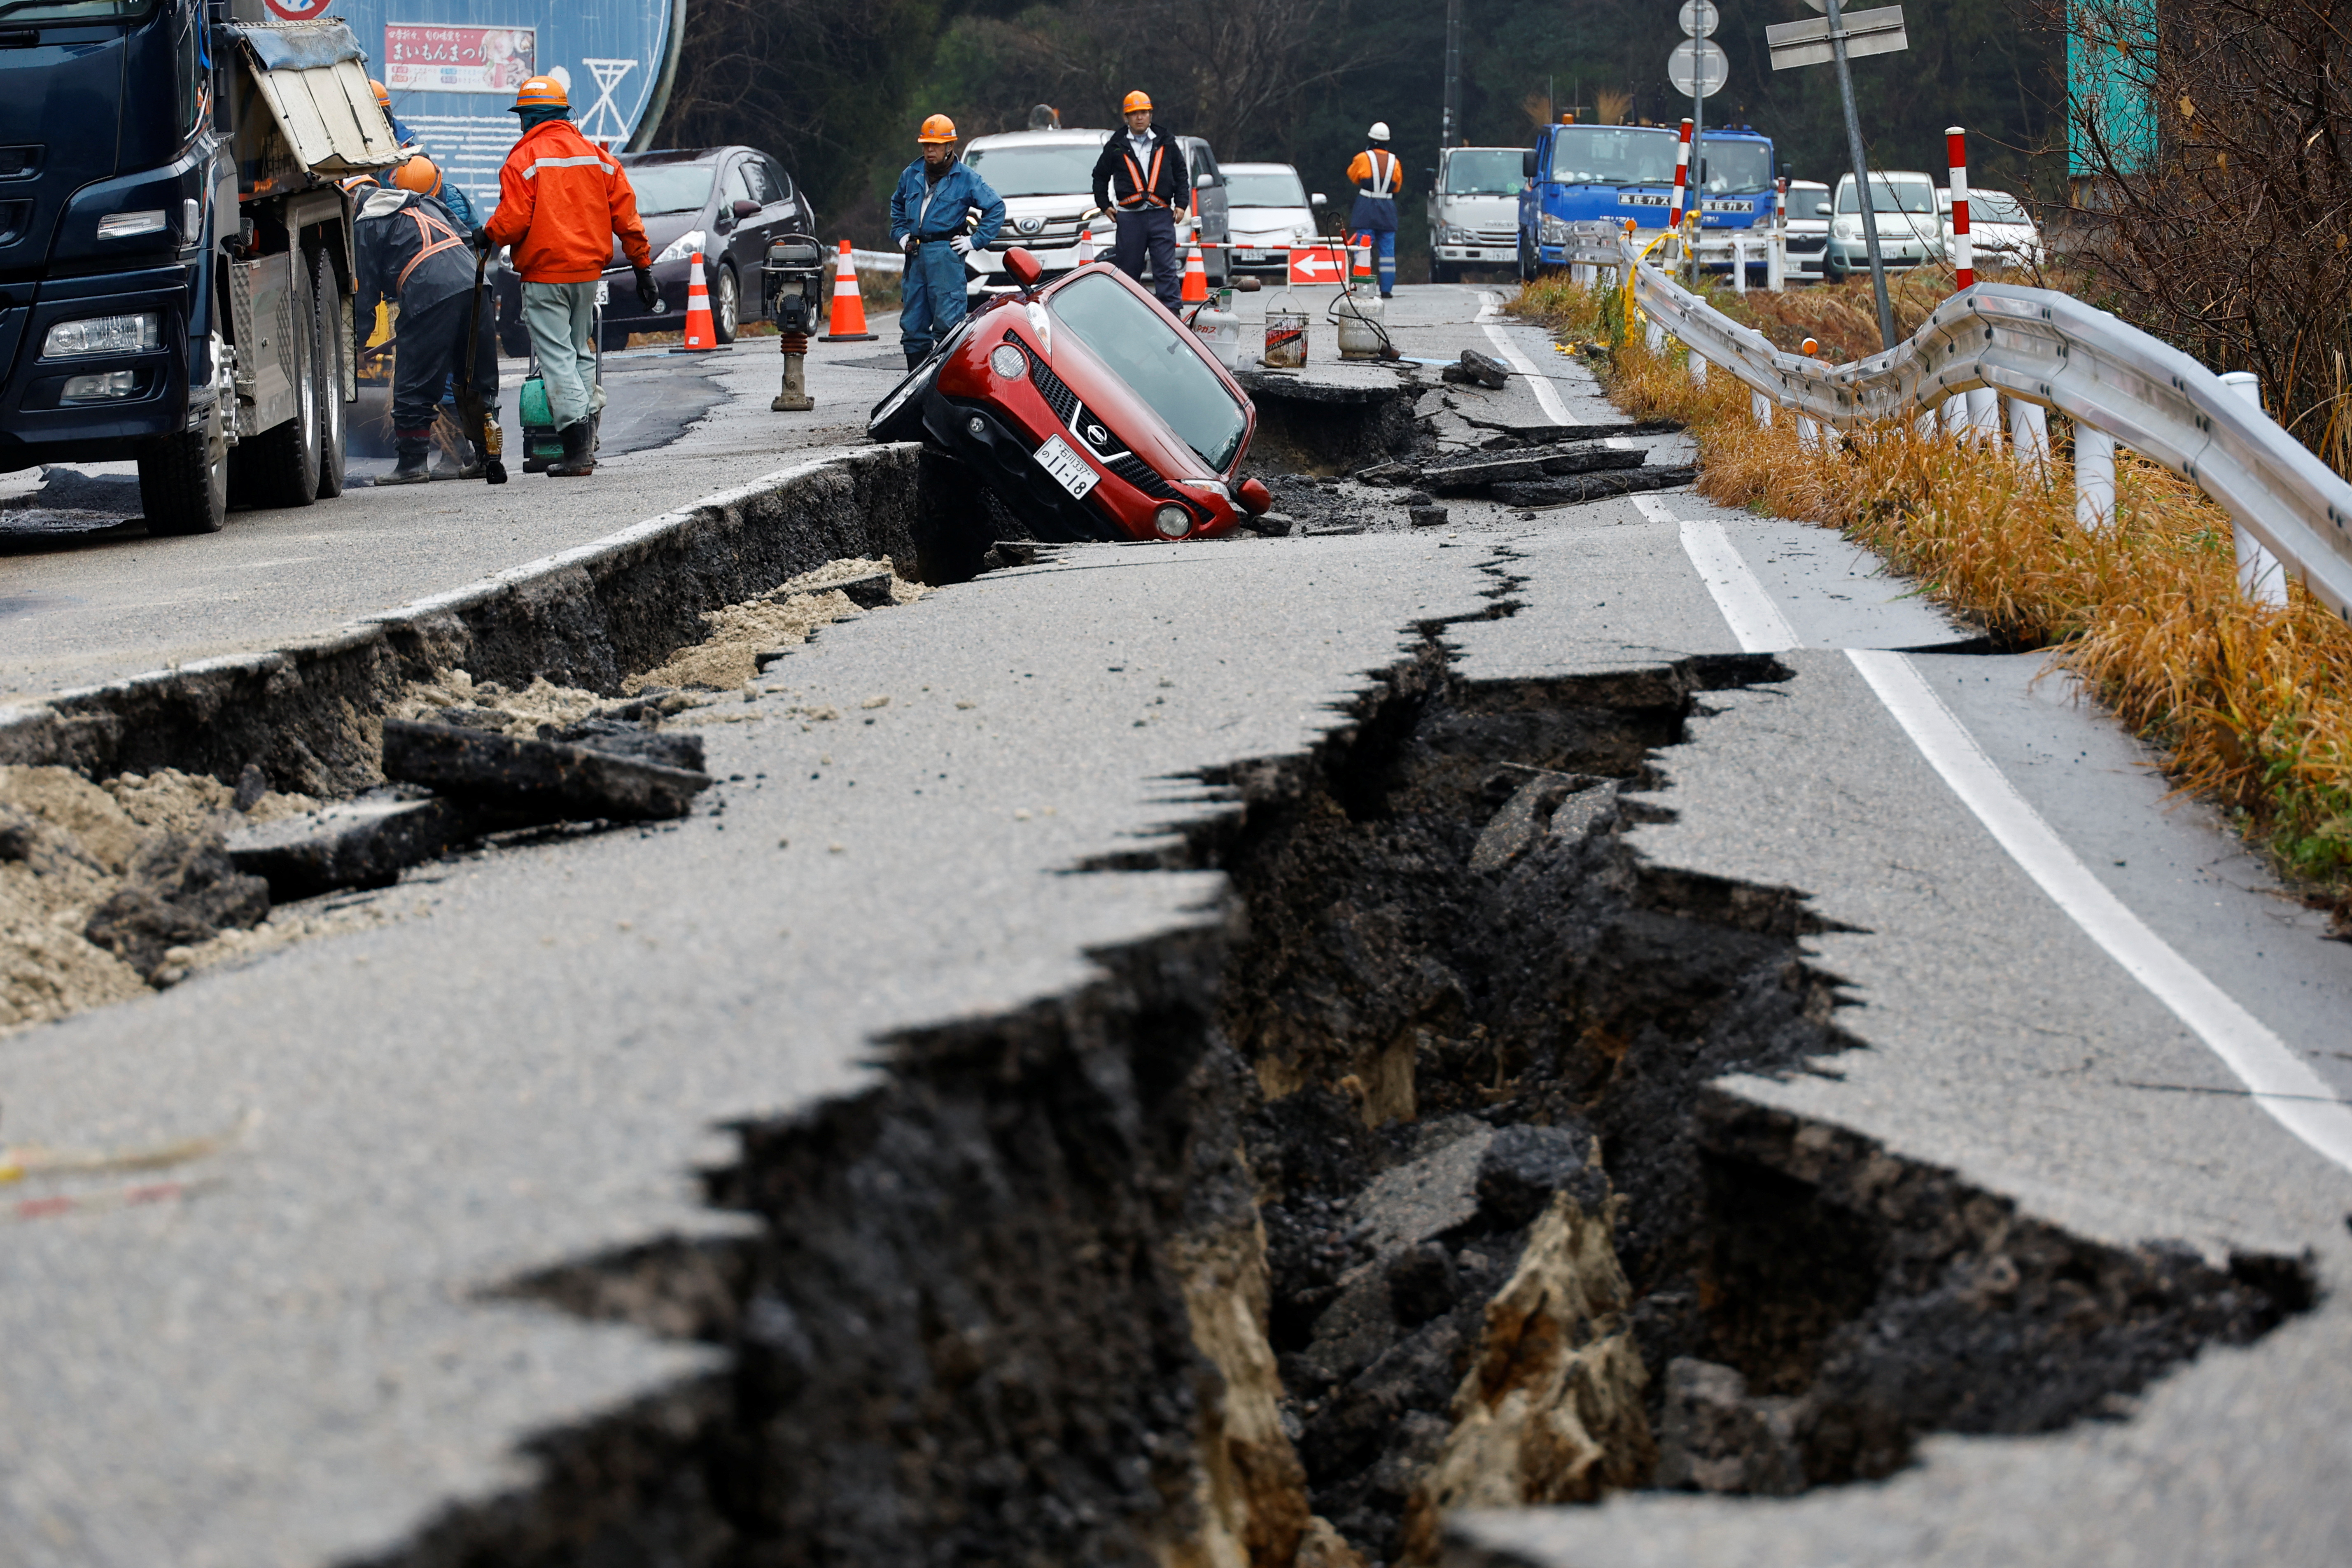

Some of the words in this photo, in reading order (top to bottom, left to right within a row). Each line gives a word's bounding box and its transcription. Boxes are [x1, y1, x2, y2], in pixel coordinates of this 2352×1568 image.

[393, 42, 488, 62] まいもんまつり
[1620, 194, 1669, 205] 高圧ガス
[1701, 201, 1750, 211] 高圧ガス
[1090, 427, 1105, 441] NISSAN
[1042, 450, 1050, 458] の
[1047, 455, 1087, 495] 11-18
